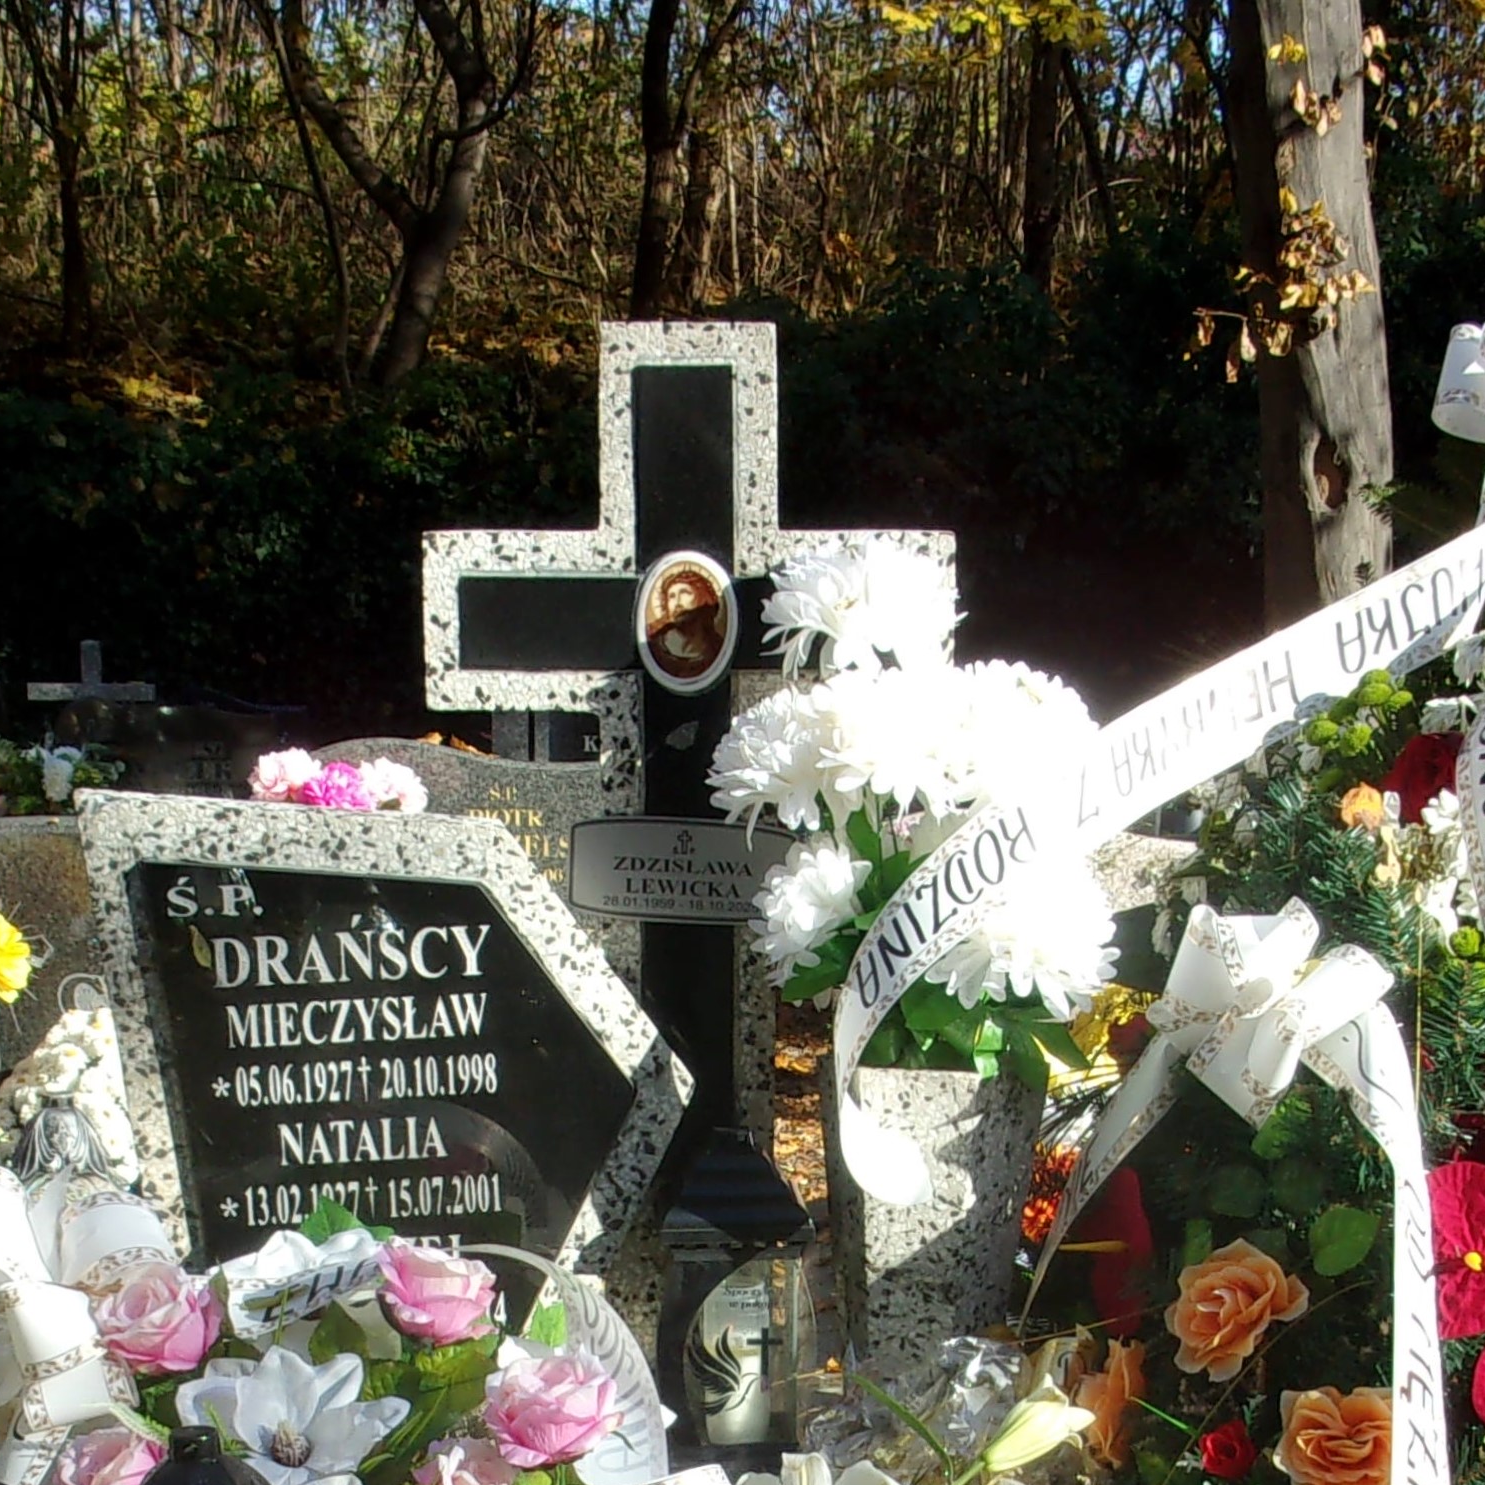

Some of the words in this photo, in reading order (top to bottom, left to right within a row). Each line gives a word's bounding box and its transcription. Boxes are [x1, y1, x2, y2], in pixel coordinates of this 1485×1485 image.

[165, 875, 264, 919] Ś.P.
[625, 877, 741, 899] LEWICKA
[211, 913, 492, 990] DRAŃSCY
[224, 991, 489, 1050] MIECZYSŁAW
[379, 1052, 499, 1099] 20.10.1998
[278, 1115, 449, 1168] NATALIA
[386, 1172, 503, 1219] 15.07.2001
